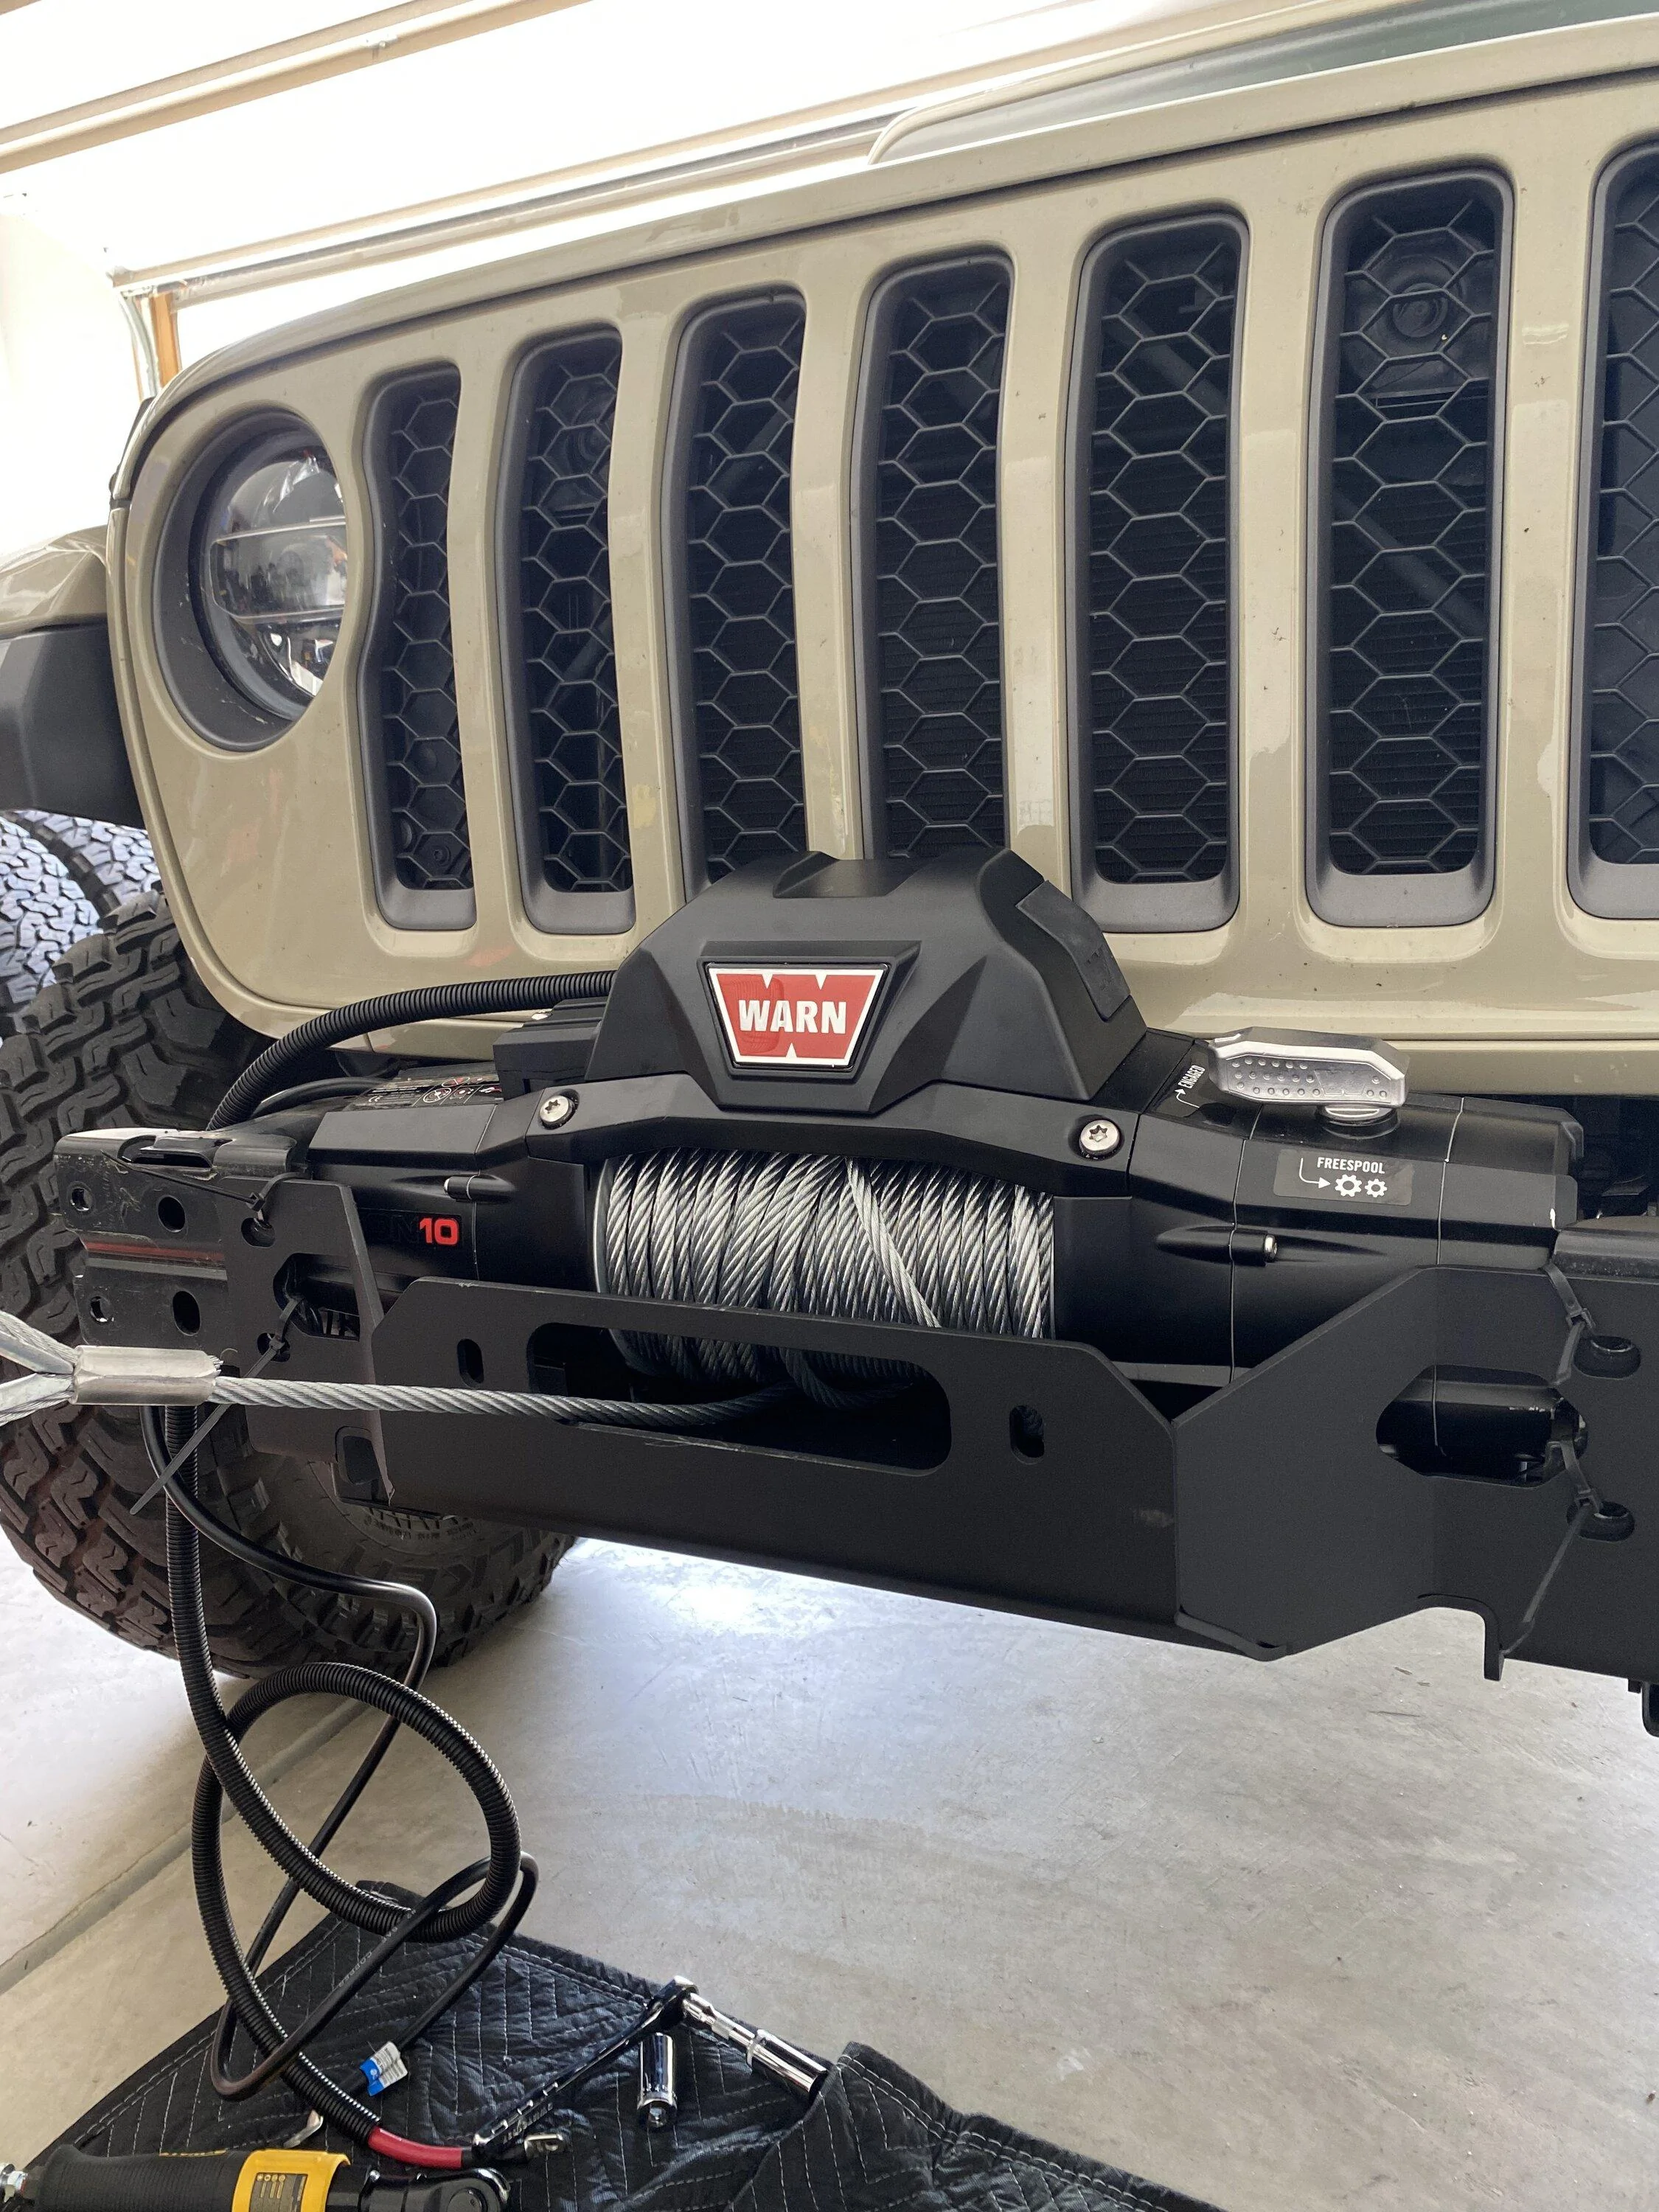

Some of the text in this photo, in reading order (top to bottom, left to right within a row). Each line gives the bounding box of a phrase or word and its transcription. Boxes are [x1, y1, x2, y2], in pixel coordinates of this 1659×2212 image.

[739, 1000, 846, 1034] WARN
[1178, 1065, 1206, 1089] ENGAGED
[1317, 1157, 1385, 1175] FREESPOOL
[419, 1217, 459, 1245] 10
